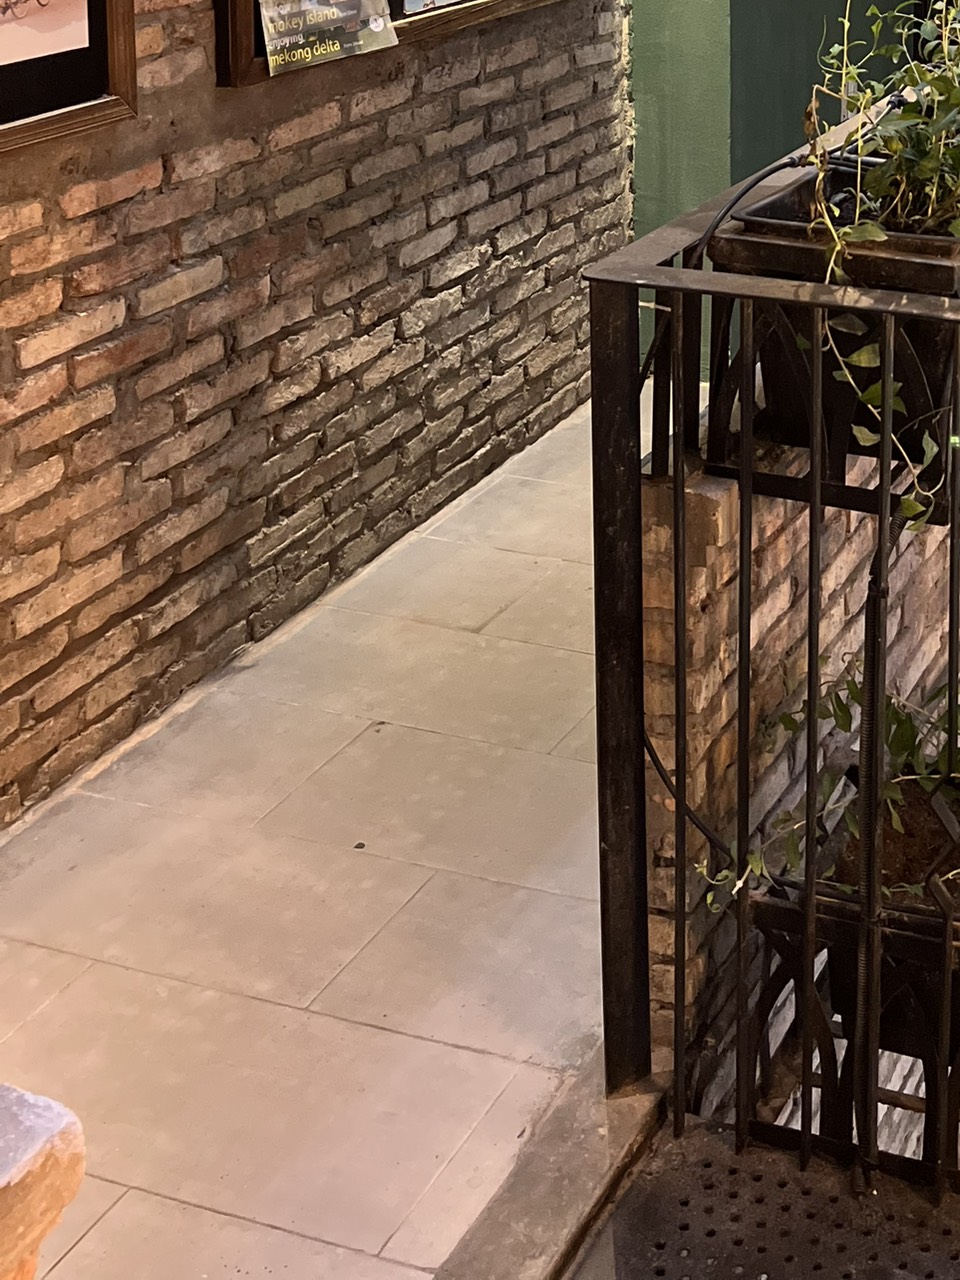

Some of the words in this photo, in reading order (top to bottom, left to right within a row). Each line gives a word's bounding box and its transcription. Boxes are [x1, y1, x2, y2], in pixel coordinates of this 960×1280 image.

[305, 4, 338, 25] island
[270, 46, 312, 68] mekong
[313, 38, 341, 56] delta
